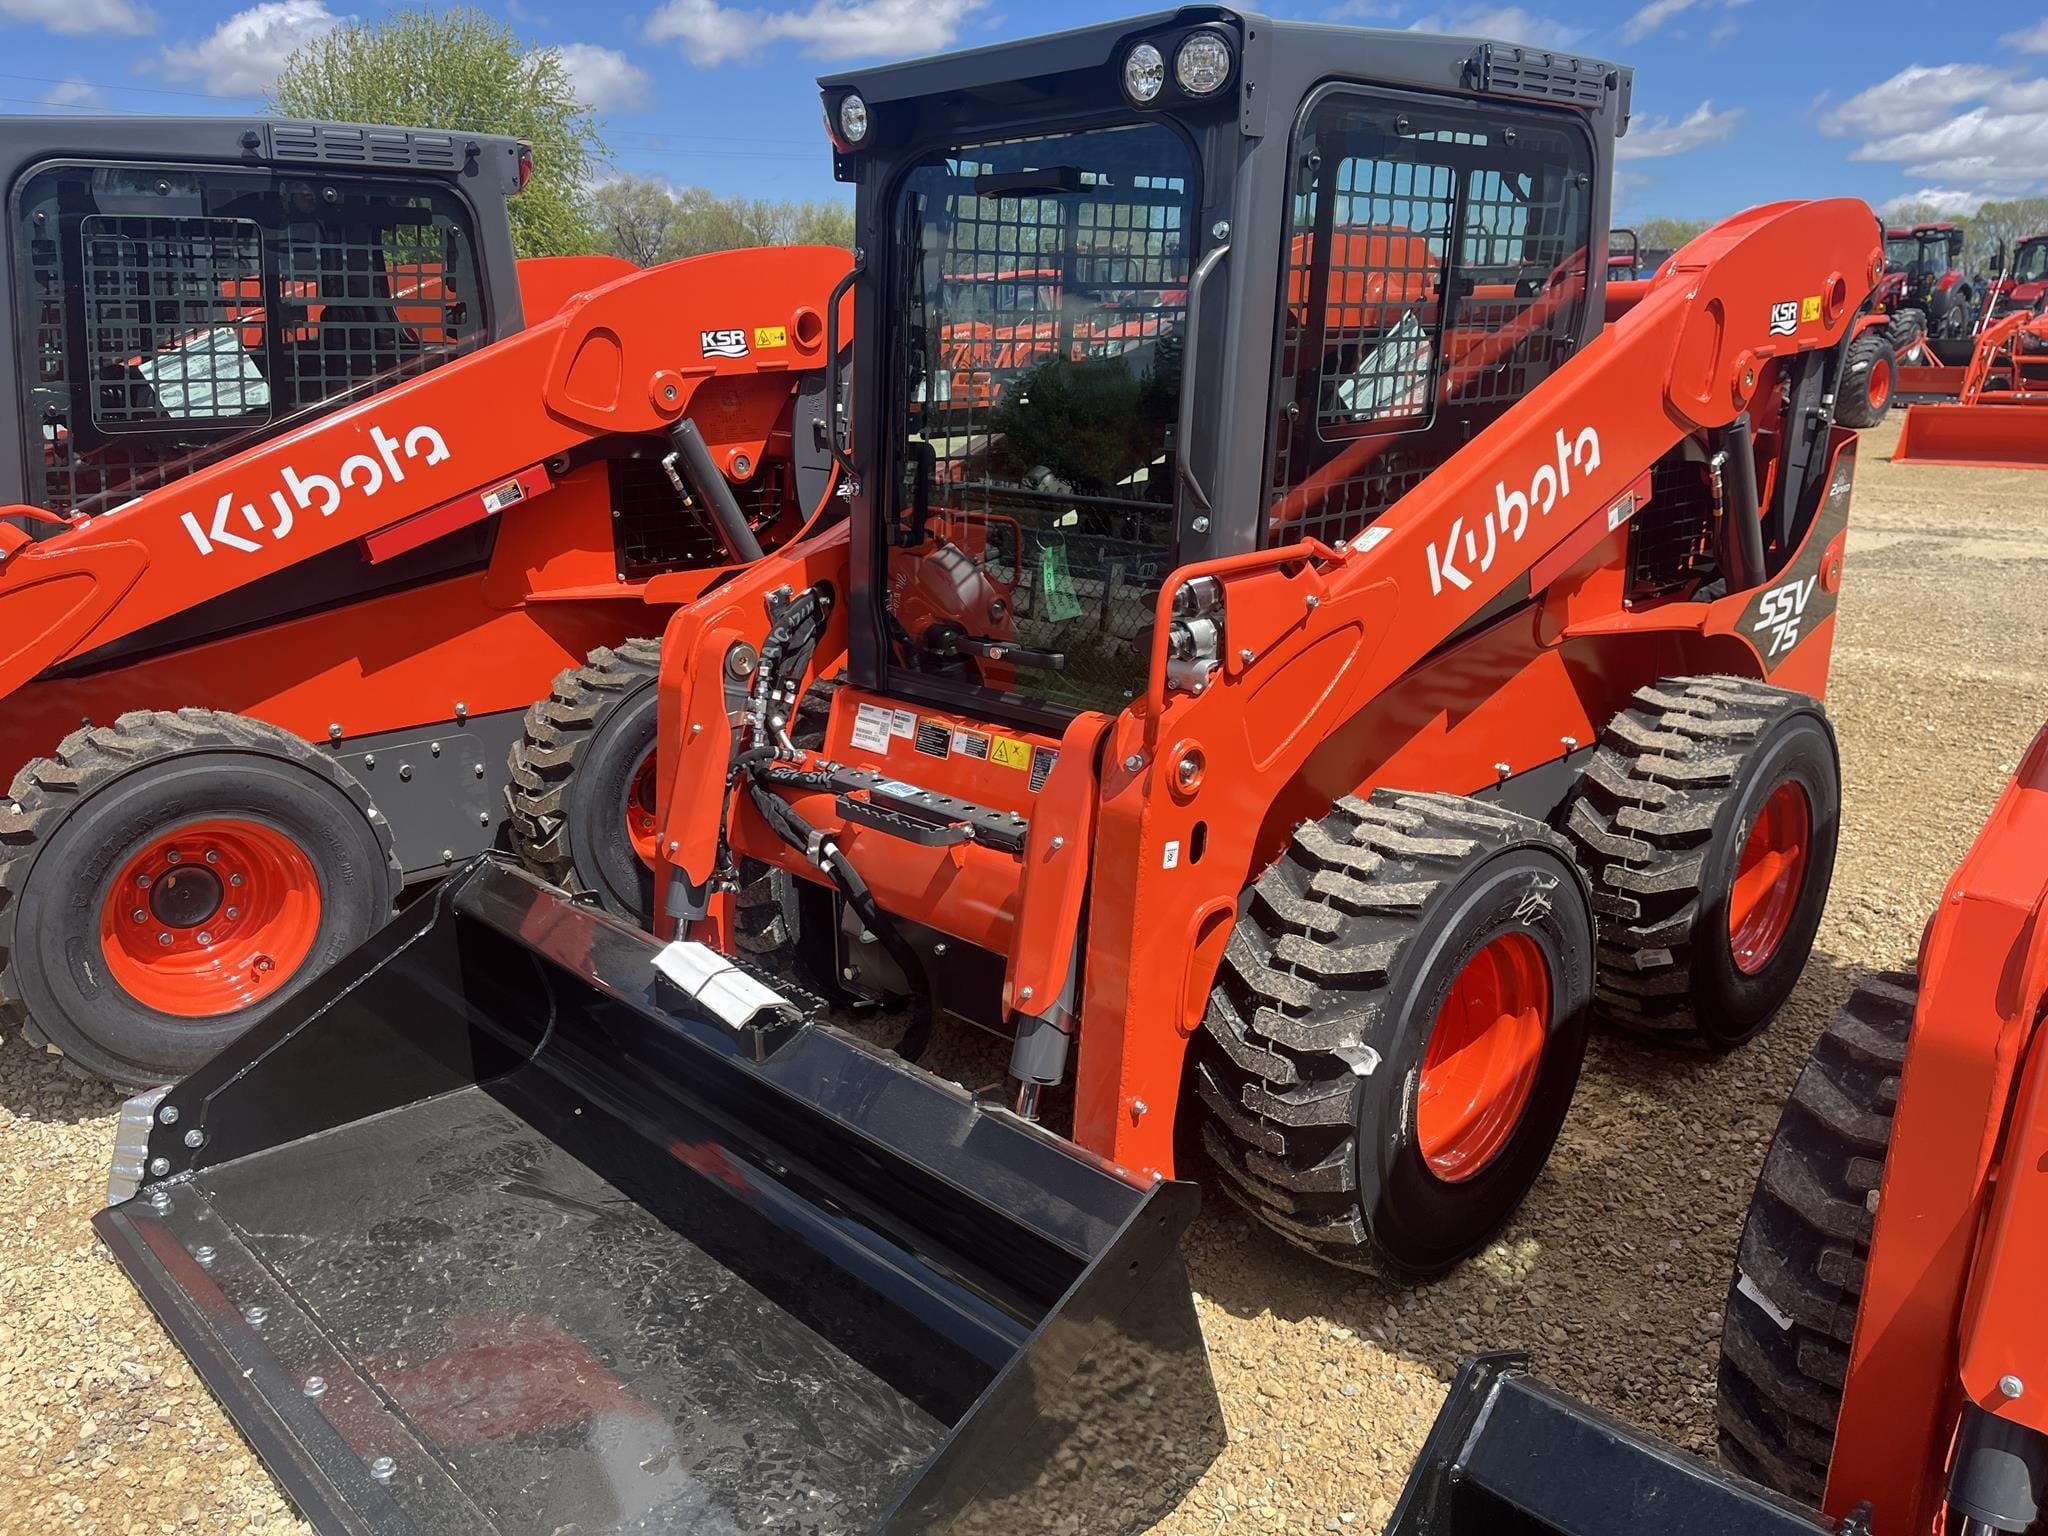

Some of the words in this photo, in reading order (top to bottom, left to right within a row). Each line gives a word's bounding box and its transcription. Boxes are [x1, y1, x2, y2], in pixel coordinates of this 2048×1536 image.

[1771, 301, 1798, 323] KSR
[701, 329, 746, 347] KSR
[181, 426, 449, 554] Kubota
[1425, 426, 1601, 596] Kubota
[1753, 574, 1818, 632] SSV
[1768, 616, 1801, 657] 75
